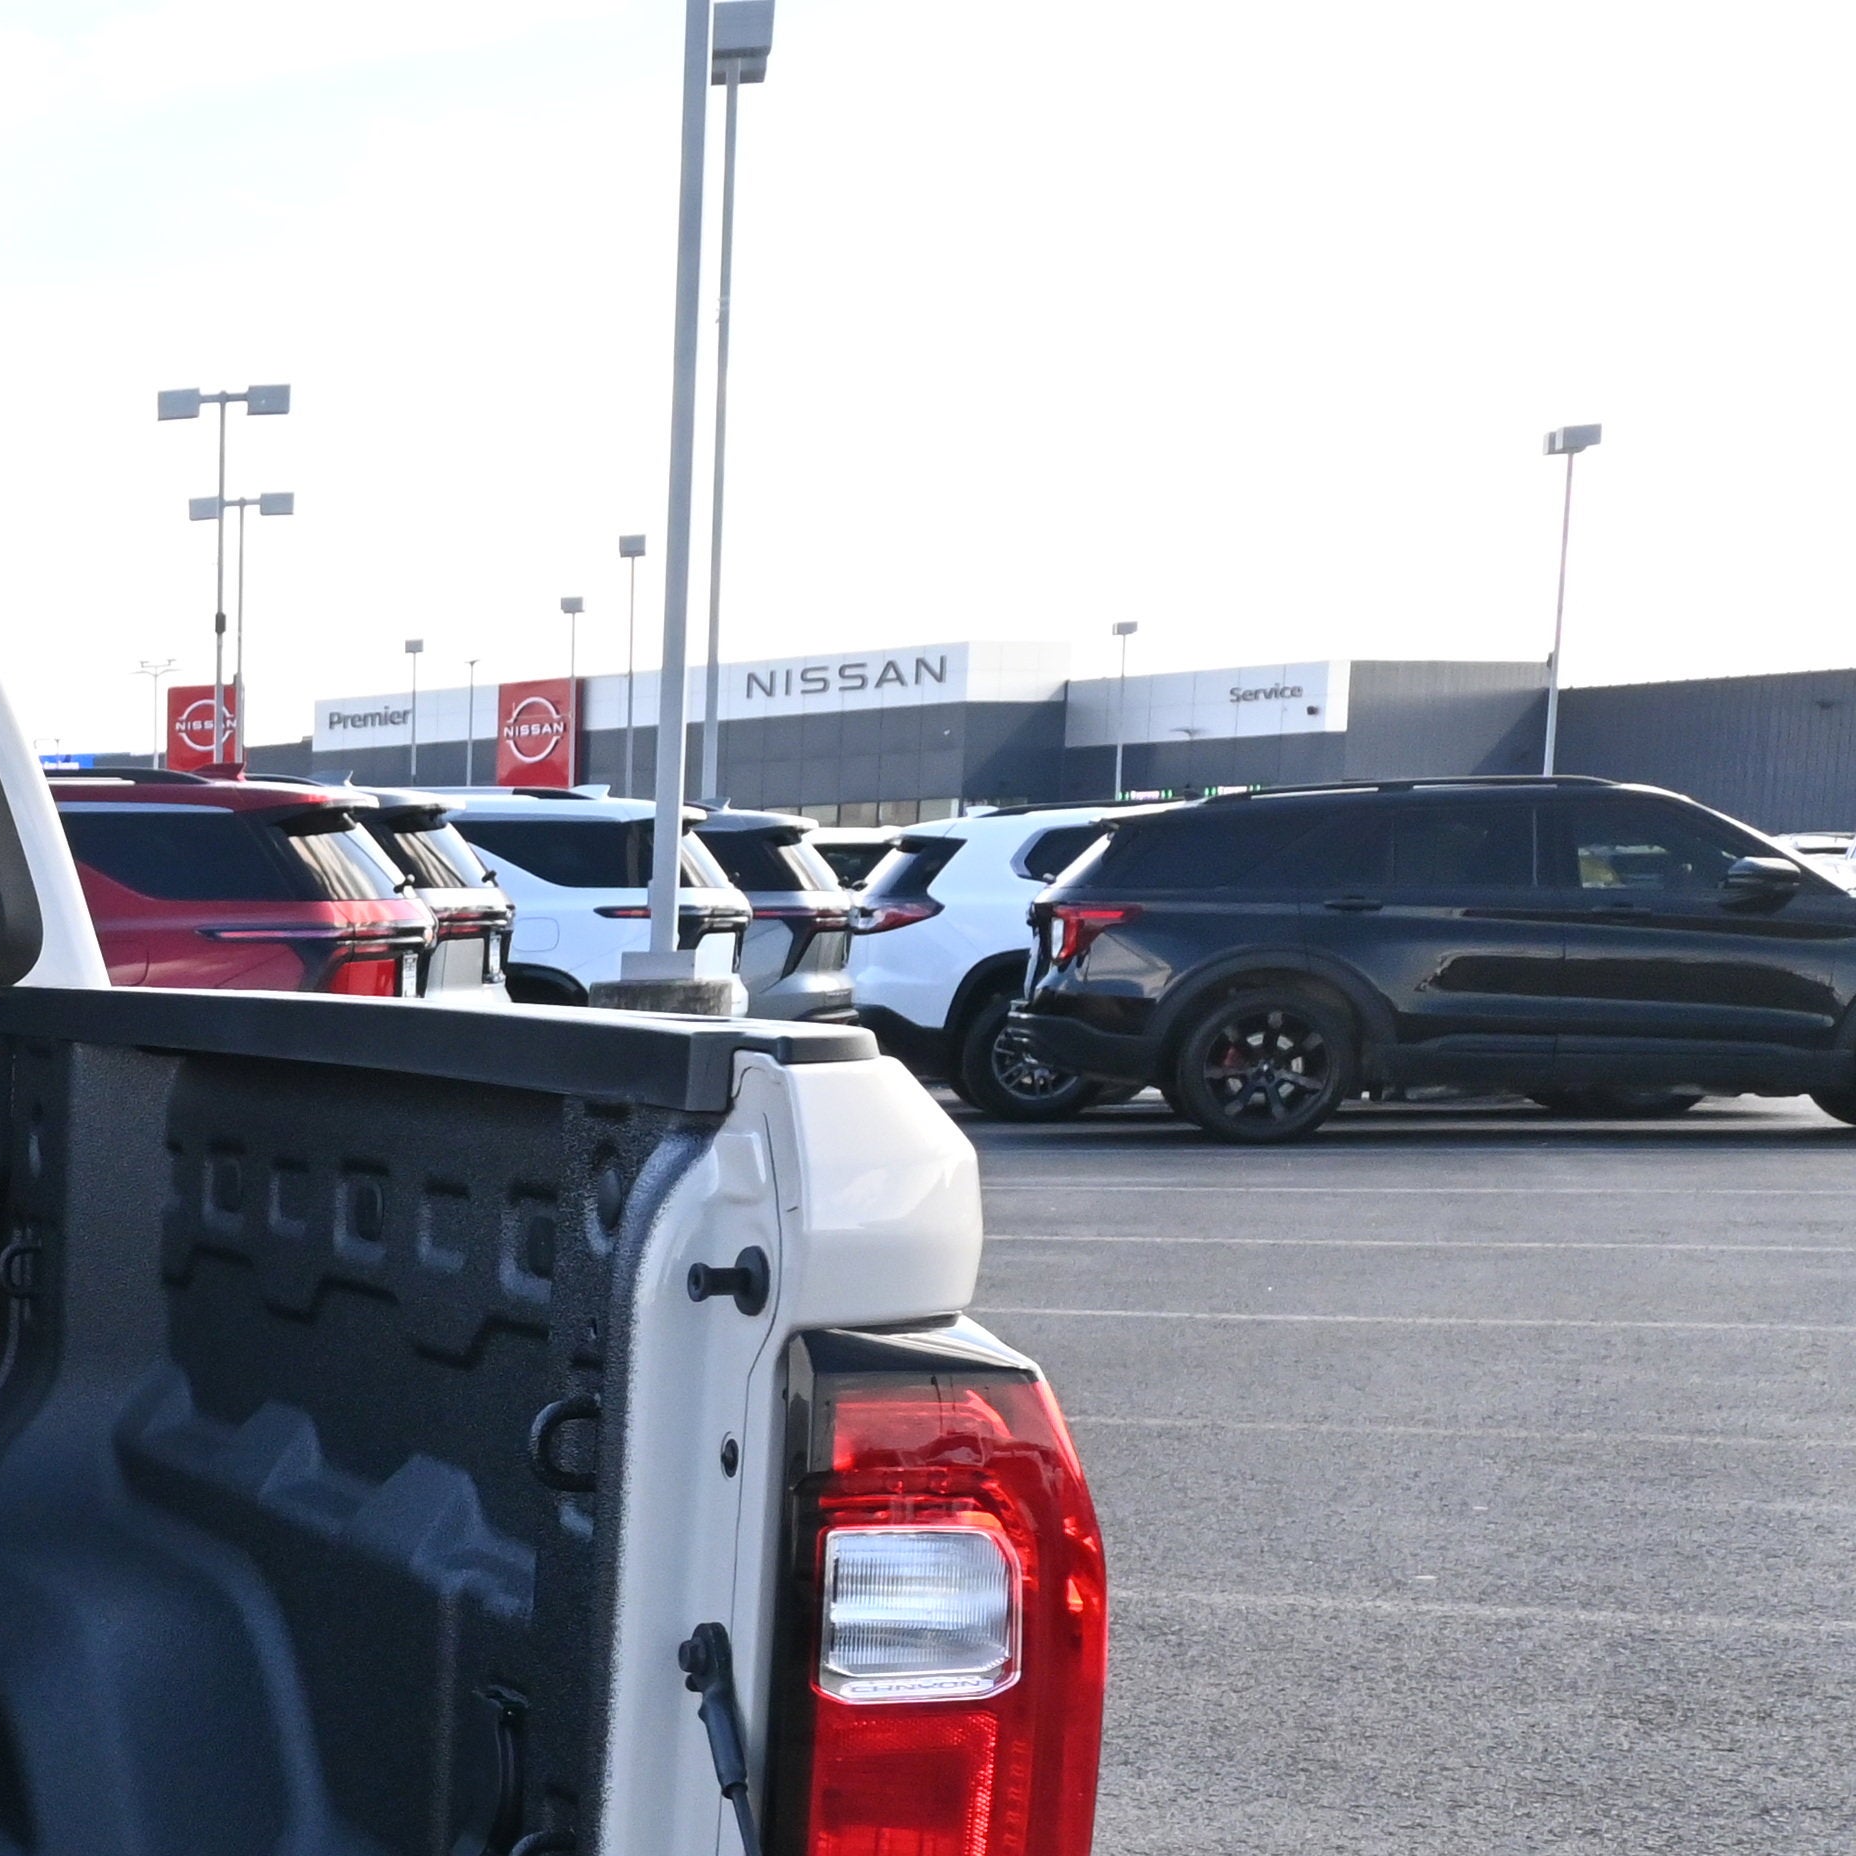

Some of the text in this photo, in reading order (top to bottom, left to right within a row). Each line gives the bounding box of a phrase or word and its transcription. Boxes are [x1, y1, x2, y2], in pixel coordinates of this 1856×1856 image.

[746, 655, 948, 699] NISSAN
[1229, 683, 1303, 703] Service
[175, 719, 238, 732] NISSN
[328, 705, 412, 730] Premier
[503, 722, 565, 737] NISSAN
